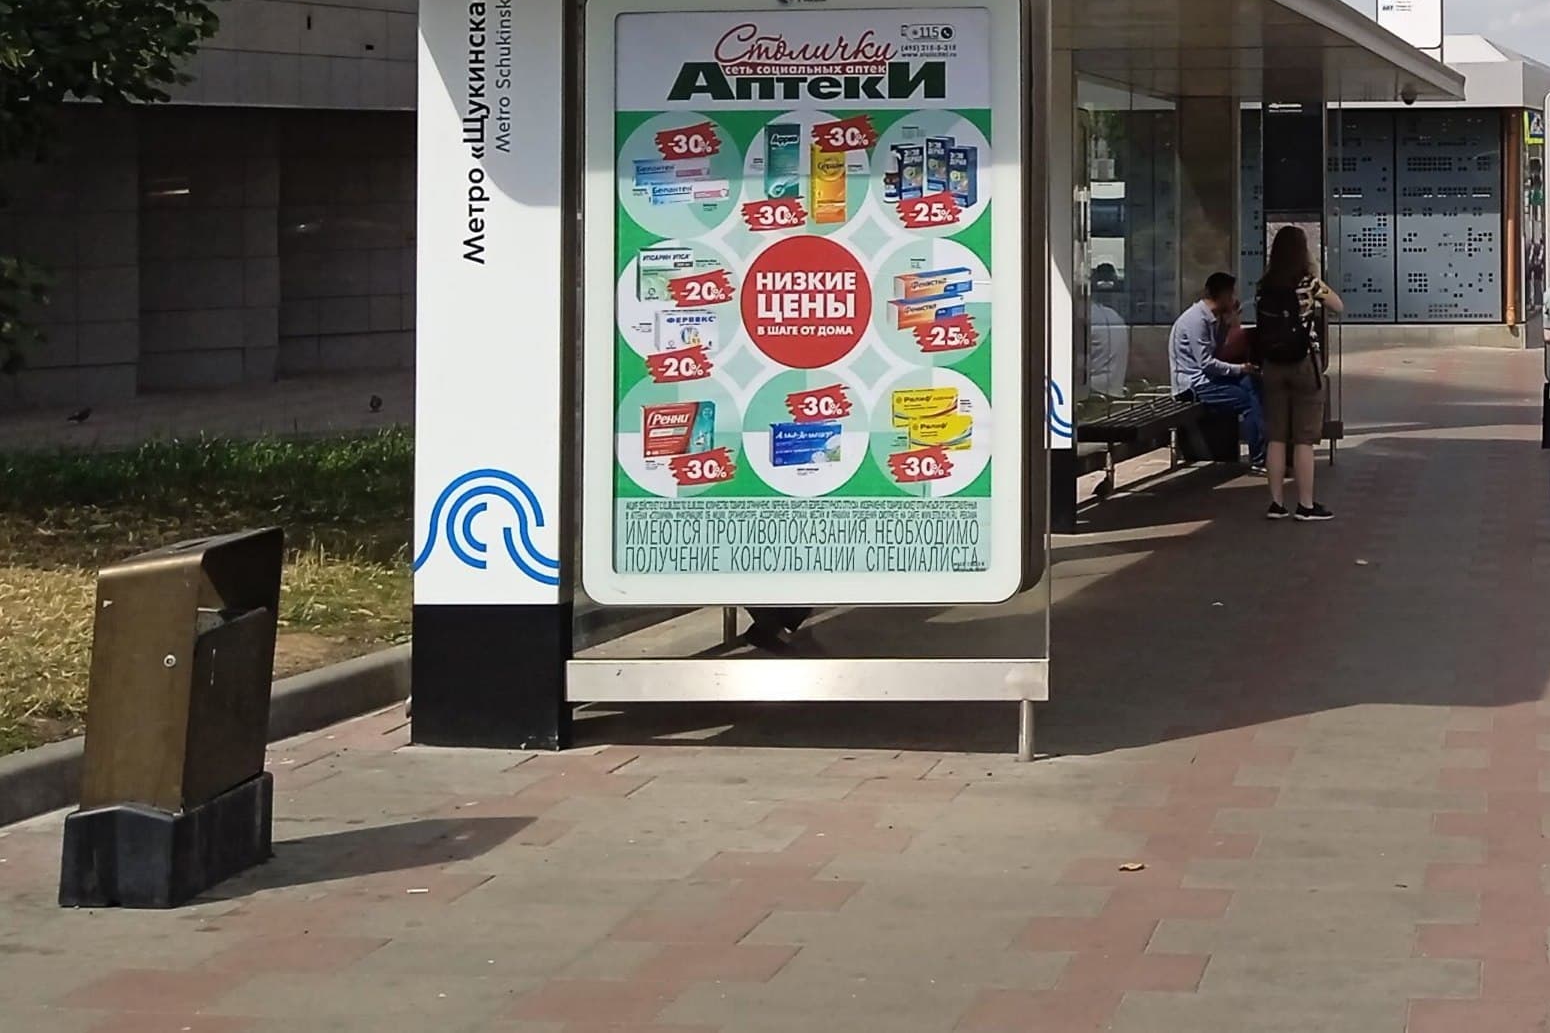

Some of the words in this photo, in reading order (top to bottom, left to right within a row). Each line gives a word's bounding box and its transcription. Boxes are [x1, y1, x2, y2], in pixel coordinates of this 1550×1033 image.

[714, 23, 898, 63] Столички
[725, 66, 753, 75] сеть
[756, 65, 842, 76] социальных
[845, 65, 886, 74] аптек
[495, 96, 511, 153] Metro
[668, 134, 712, 154] -30%
[824, 127, 869, 146] -30%
[463, 167, 490, 265] Метро
[754, 205, 798, 225] -30%
[909, 202, 953, 222] -25%
[681, 281, 726, 301] -20%
[756, 272, 857, 290] НИЗКИЕ
[757, 293, 855, 323] ЦЕНЫ
[757, 326, 765, 335] В
[767, 326, 799, 335] ШАГЕ
[800, 326, 815, 335] ОТ
[817, 326, 854, 337] ДОМА
[925, 327, 969, 346] -25%
[658, 357, 704, 377] -20%
[799, 396, 843, 416] -30%
[651, 413, 689, 426] Ренни
[682, 460, 728, 479] -30%
[900, 456, 945, 477] -30%
[625, 519, 701, 545] ИМЕЮТСЯ
[706, 519, 871, 545] ПРОТИВОПОКАЗАНИЯ.
[875, 519, 980, 547] НЕОБХОДИМО
[625, 546, 720, 572] ПОЛУЧЕНИЕ
[731, 545, 855, 573] КОНСУЛЬТАЦИИ
